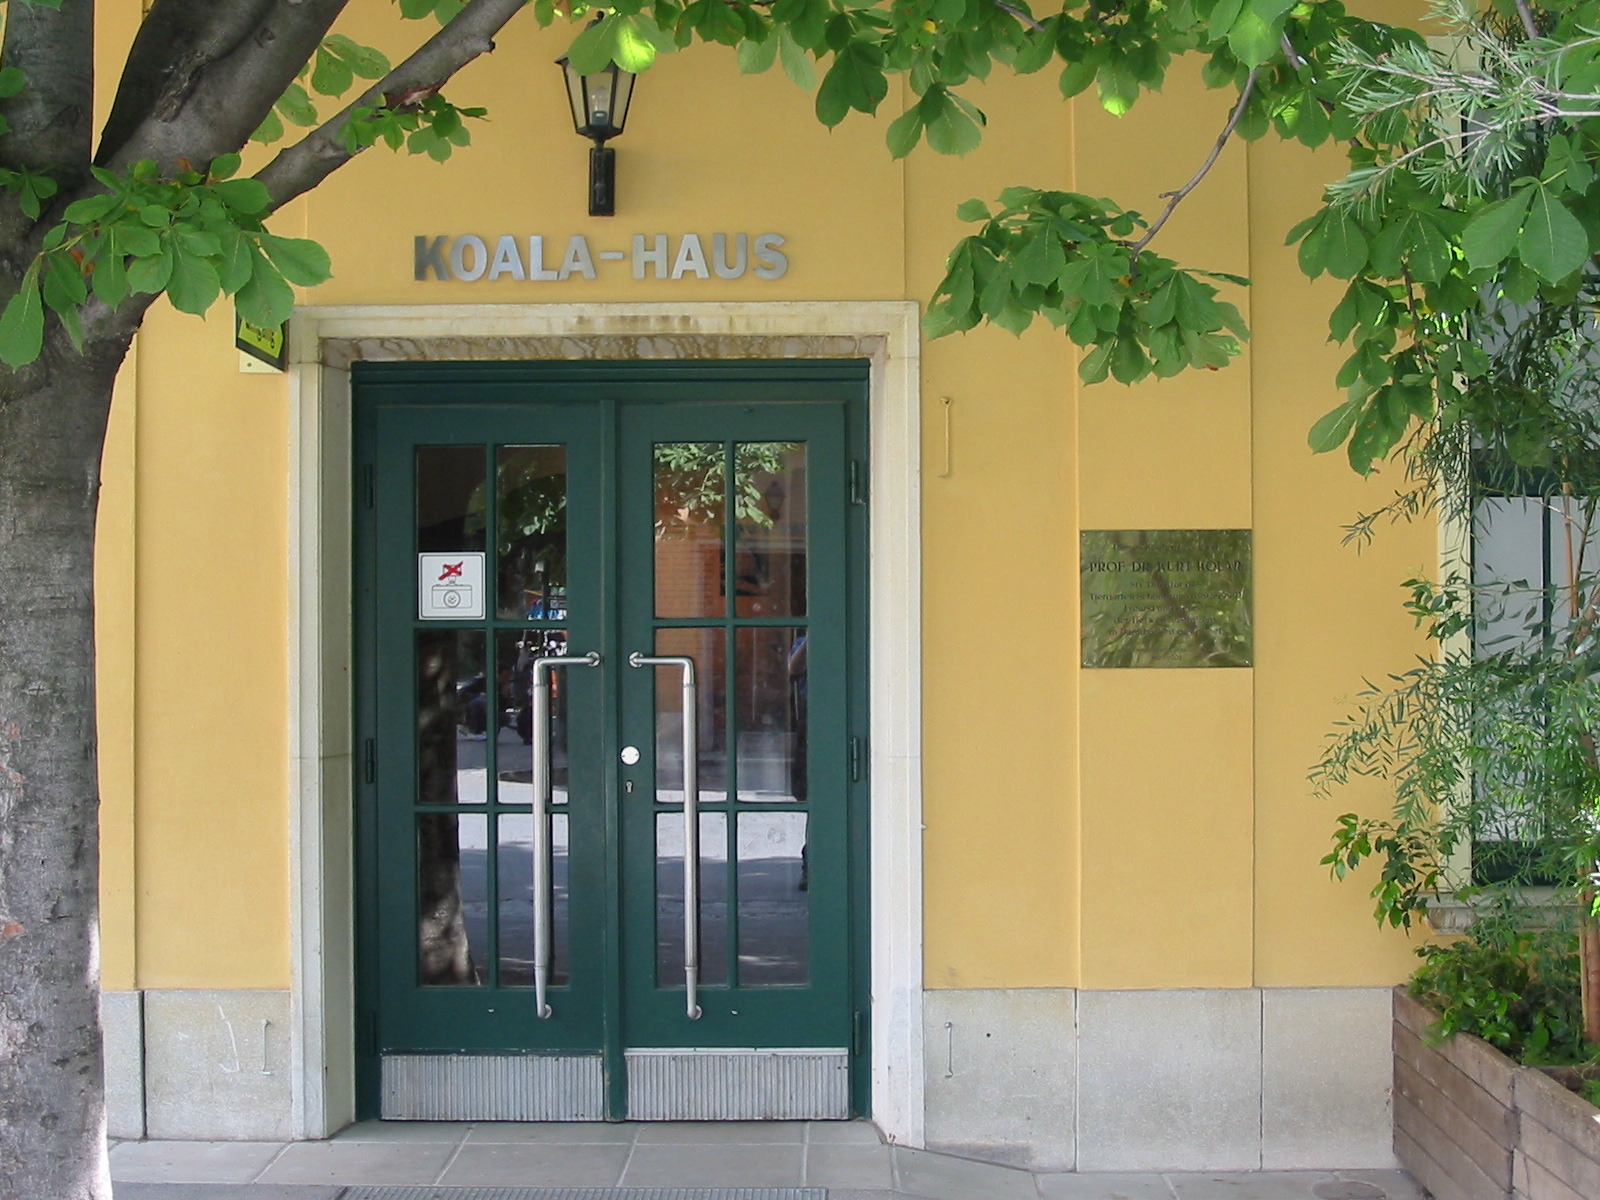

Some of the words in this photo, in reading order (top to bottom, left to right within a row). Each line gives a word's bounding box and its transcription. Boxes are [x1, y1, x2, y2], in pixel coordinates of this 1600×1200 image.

[414, 233, 788, 281] KOALA-HAUS
[1157, 561, 1191, 572] KURT
[1197, 561, 1242, 572] KOLAR
